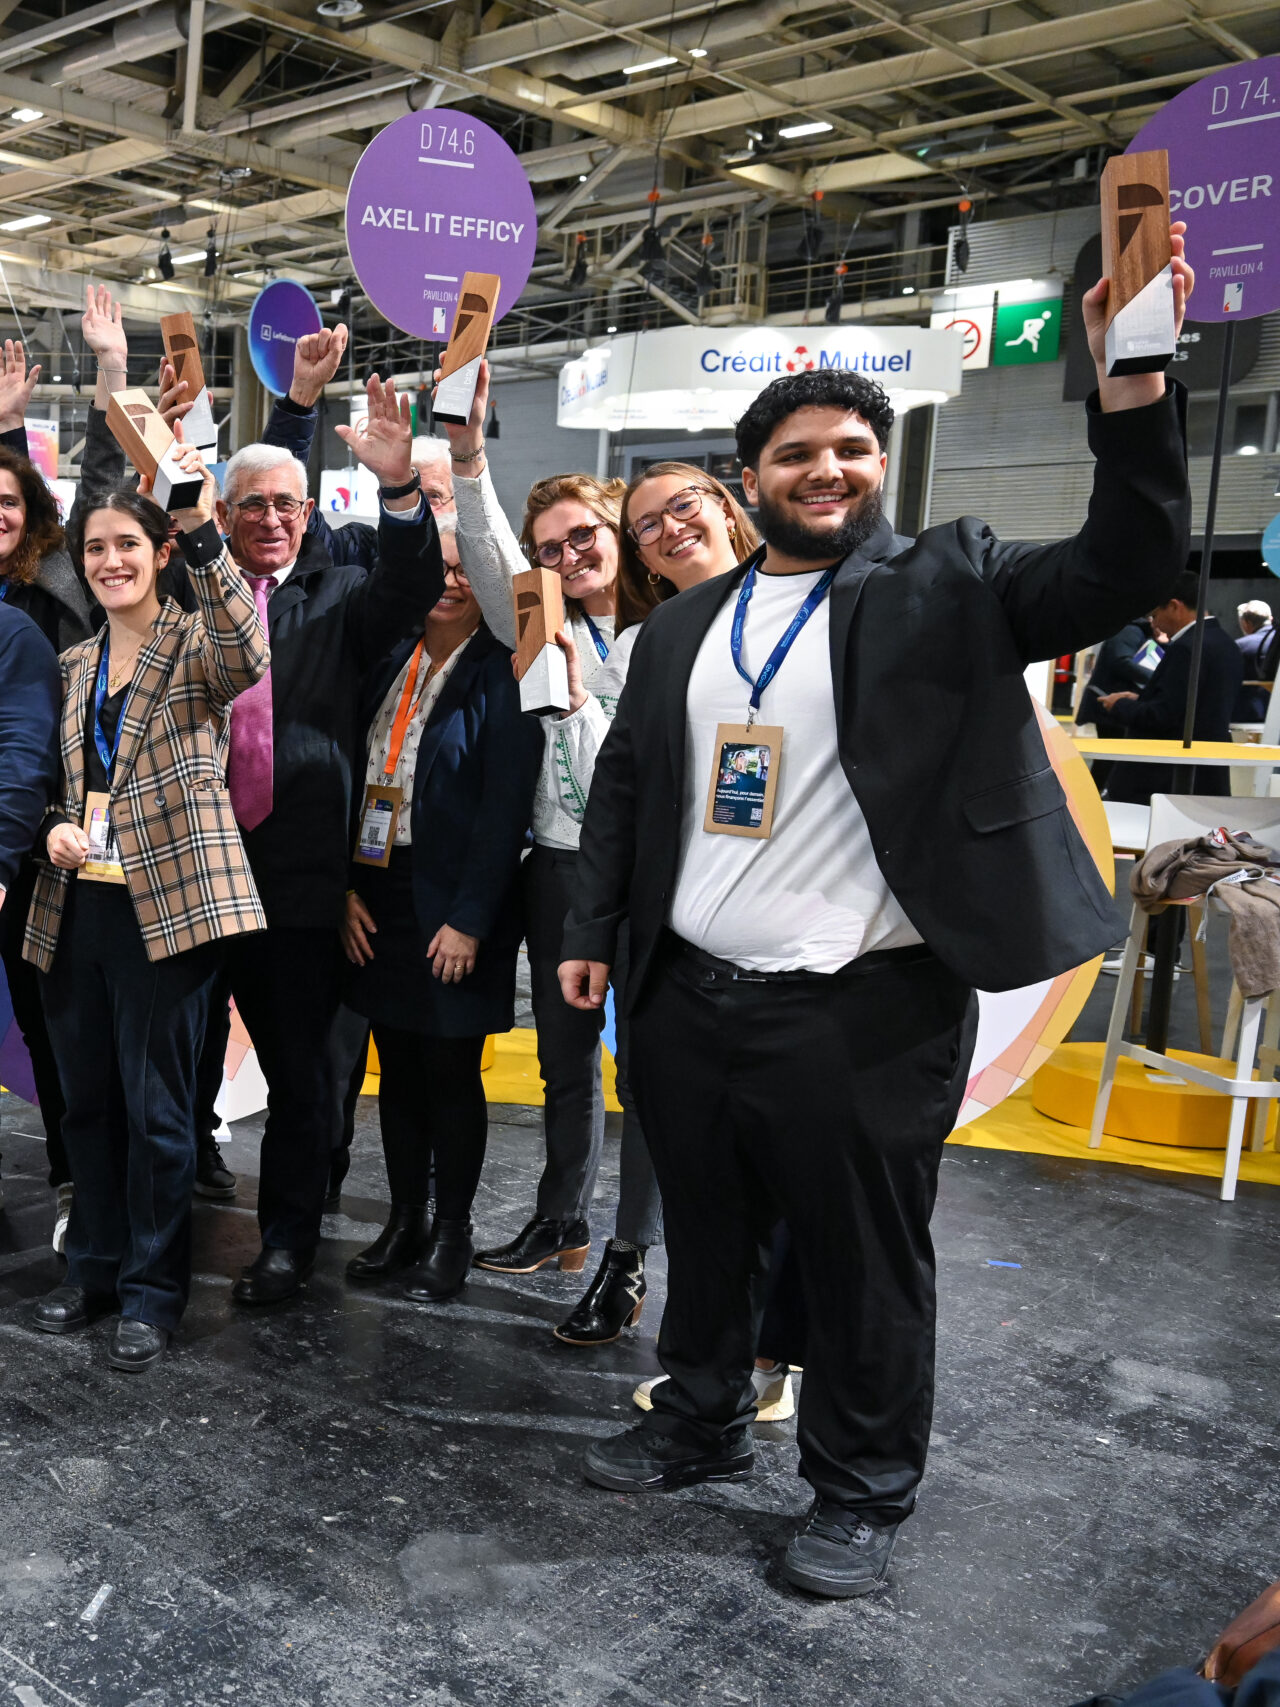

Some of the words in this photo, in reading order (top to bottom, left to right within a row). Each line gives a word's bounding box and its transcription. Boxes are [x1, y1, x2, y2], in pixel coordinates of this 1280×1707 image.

[1211, 85, 1229, 115] D
[420, 123, 432, 150] D
[438, 125, 475, 156] 74.6
[361, 205, 419, 232] AXEL
[424, 212, 445, 234] IT
[449, 215, 525, 244] EFFICY
[1209, 263, 1255, 279] PAVILLON
[1256, 261, 1264, 273] 4
[423, 289, 453, 303] PAVILLON
[701, 348, 782, 373] Crédit
[819, 349, 912, 372] Mutuel
